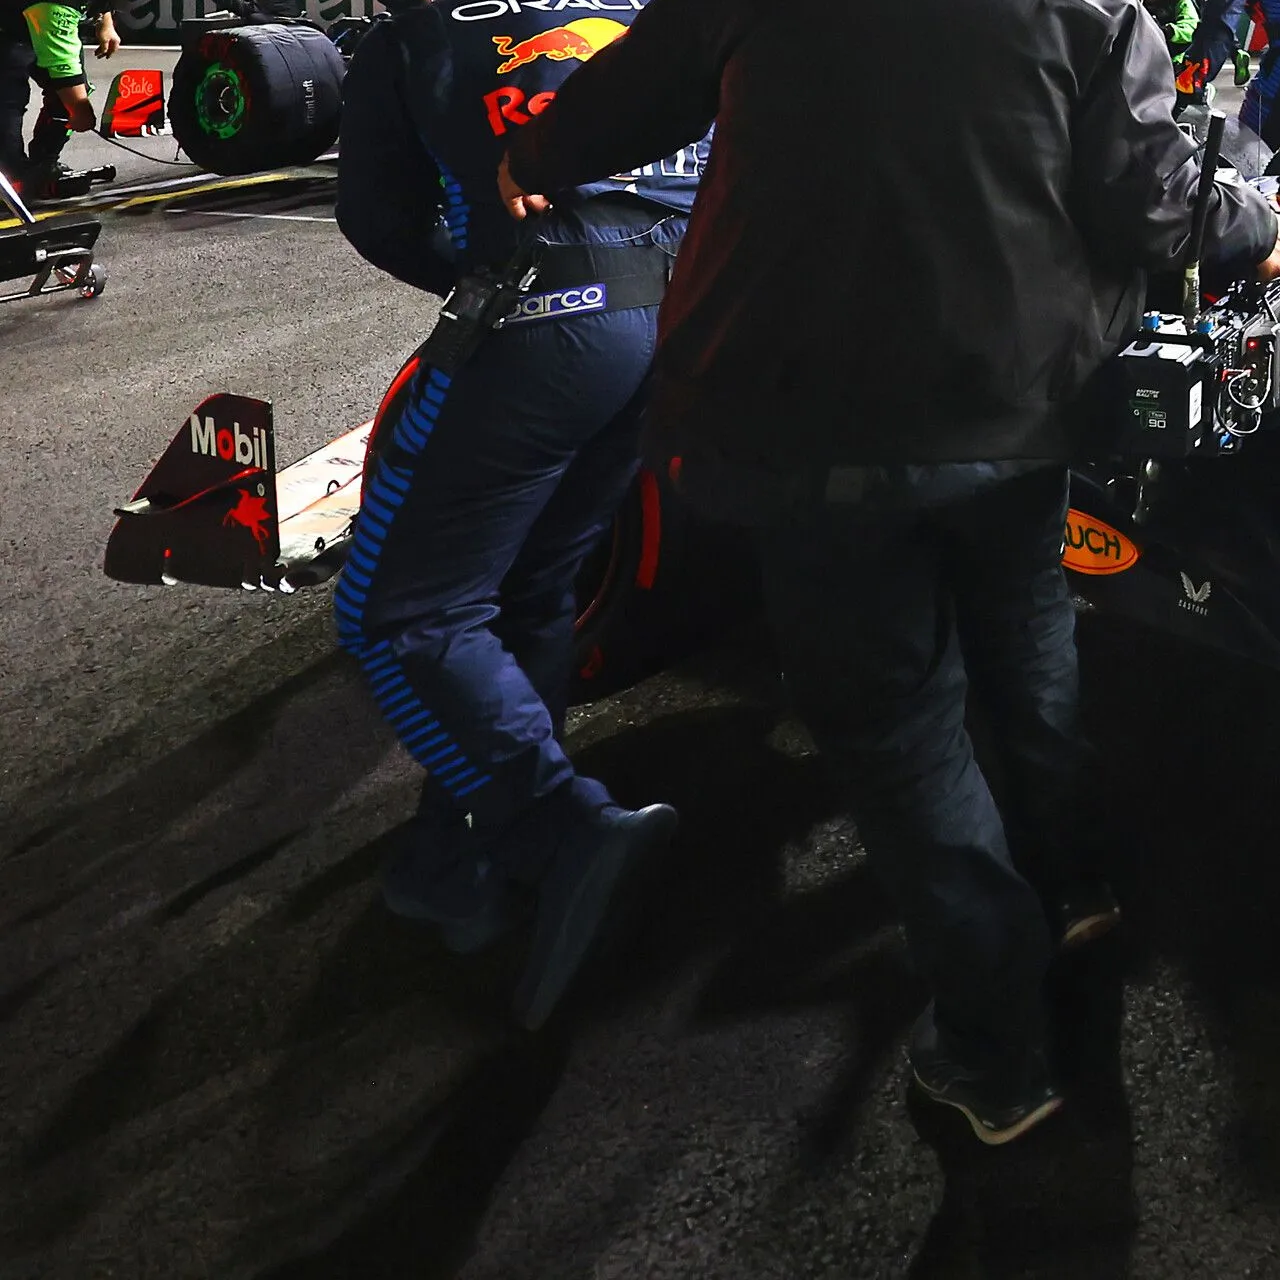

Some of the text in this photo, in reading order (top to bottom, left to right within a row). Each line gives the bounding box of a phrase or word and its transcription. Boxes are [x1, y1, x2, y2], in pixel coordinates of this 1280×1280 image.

[120, 76, 153, 99] Stake
[483, 86, 557, 136] Re
[191, 414, 268, 470] Mobil
[1149, 419, 1166, 428] 90
[1064, 522, 1121, 560] UCH
